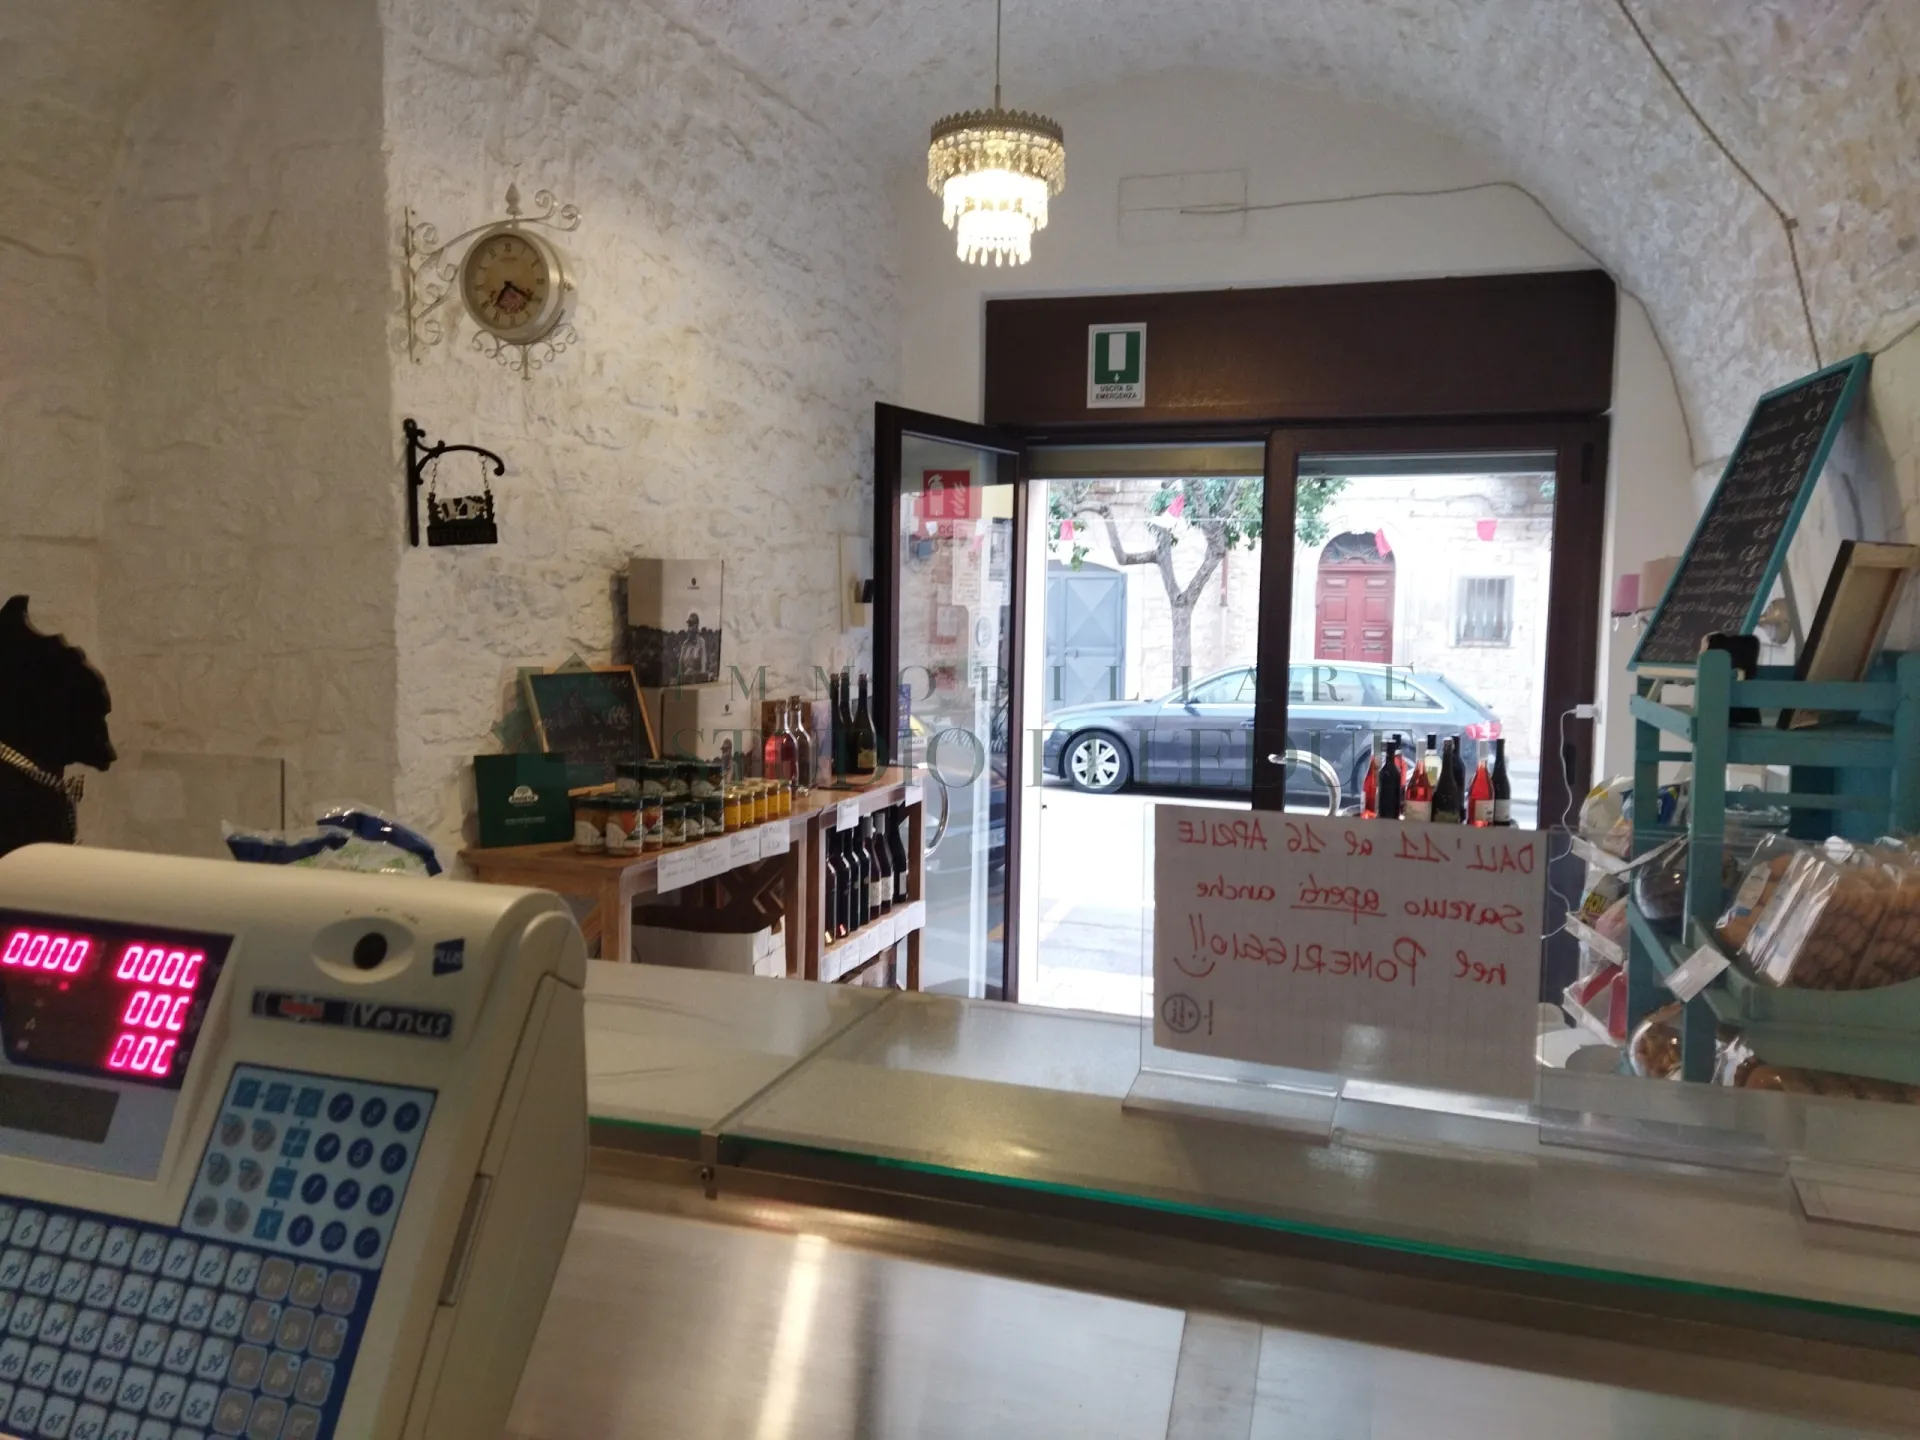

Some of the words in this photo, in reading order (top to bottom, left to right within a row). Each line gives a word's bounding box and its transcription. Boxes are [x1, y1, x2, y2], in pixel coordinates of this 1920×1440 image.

[1095, 392, 1138, 400] EMERGENZA
[2, 931, 90, 973] 0000
[359, 1002, 450, 1036] Venus
[20, 1225, 32, 1240] 6
